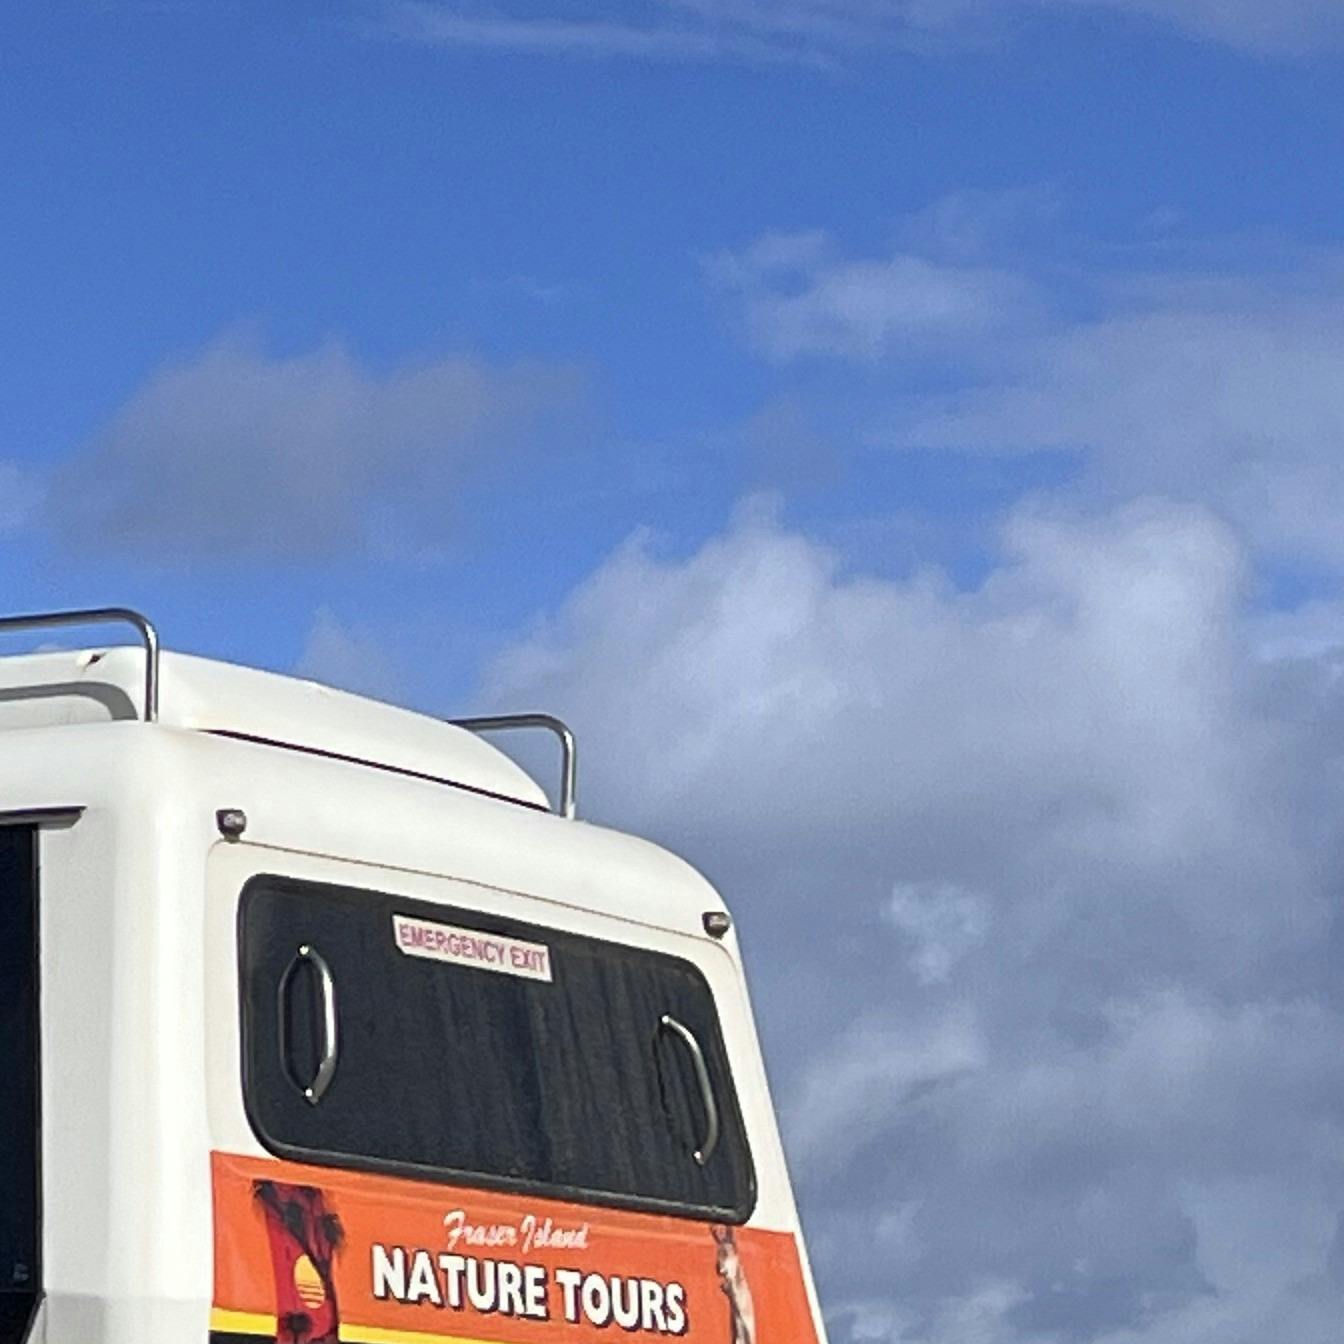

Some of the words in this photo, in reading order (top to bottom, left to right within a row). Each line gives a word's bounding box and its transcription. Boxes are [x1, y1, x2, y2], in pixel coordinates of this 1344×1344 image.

[398, 923, 506, 965] EMERGENCY
[509, 944, 546, 973] EXIT
[443, 1208, 517, 1251] Fraser
[520, 1214, 591, 1255] Island
[370, 1242, 550, 1320] NATURE
[555, 1267, 690, 1336] TOURS
